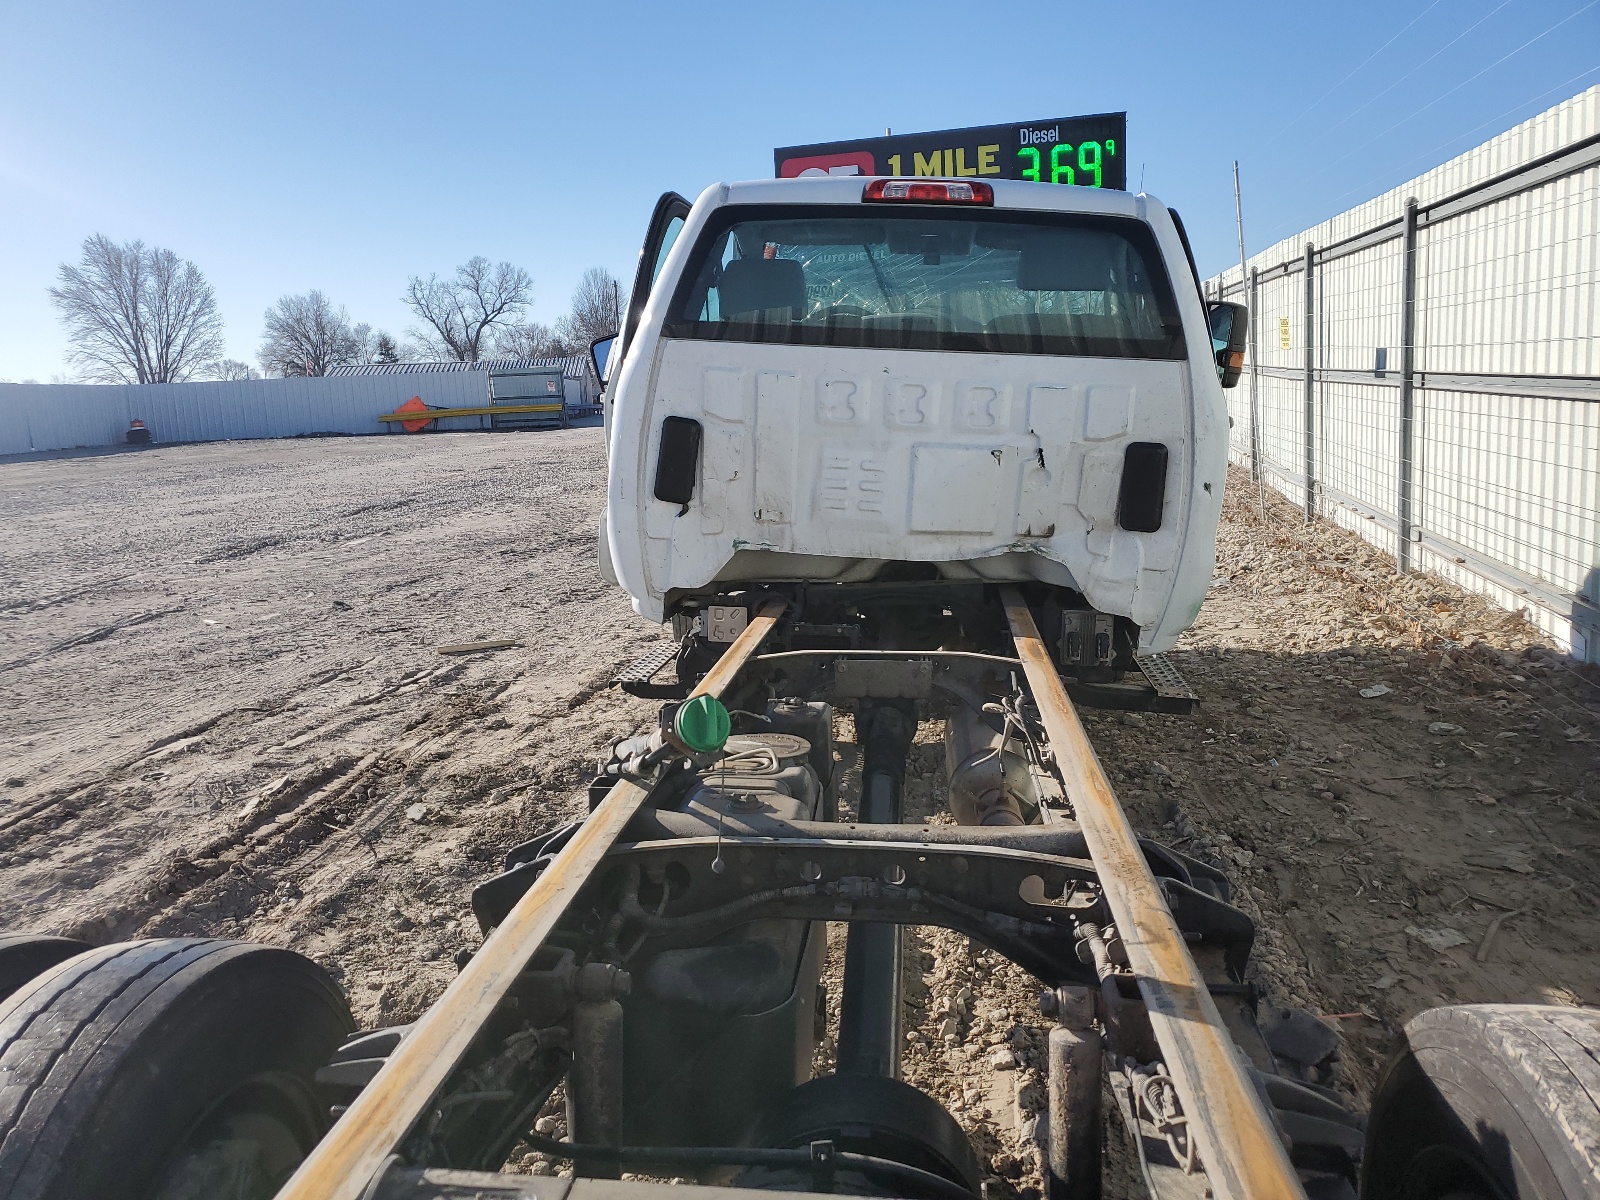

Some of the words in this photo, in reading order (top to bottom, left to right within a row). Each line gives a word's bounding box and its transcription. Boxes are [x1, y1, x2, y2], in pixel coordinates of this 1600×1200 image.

[1020, 125, 1060, 145] Diesel
[887, 154, 901, 176] 1
[913, 144, 1001, 177] MILE
[848, 249, 887, 262] DIEEL
